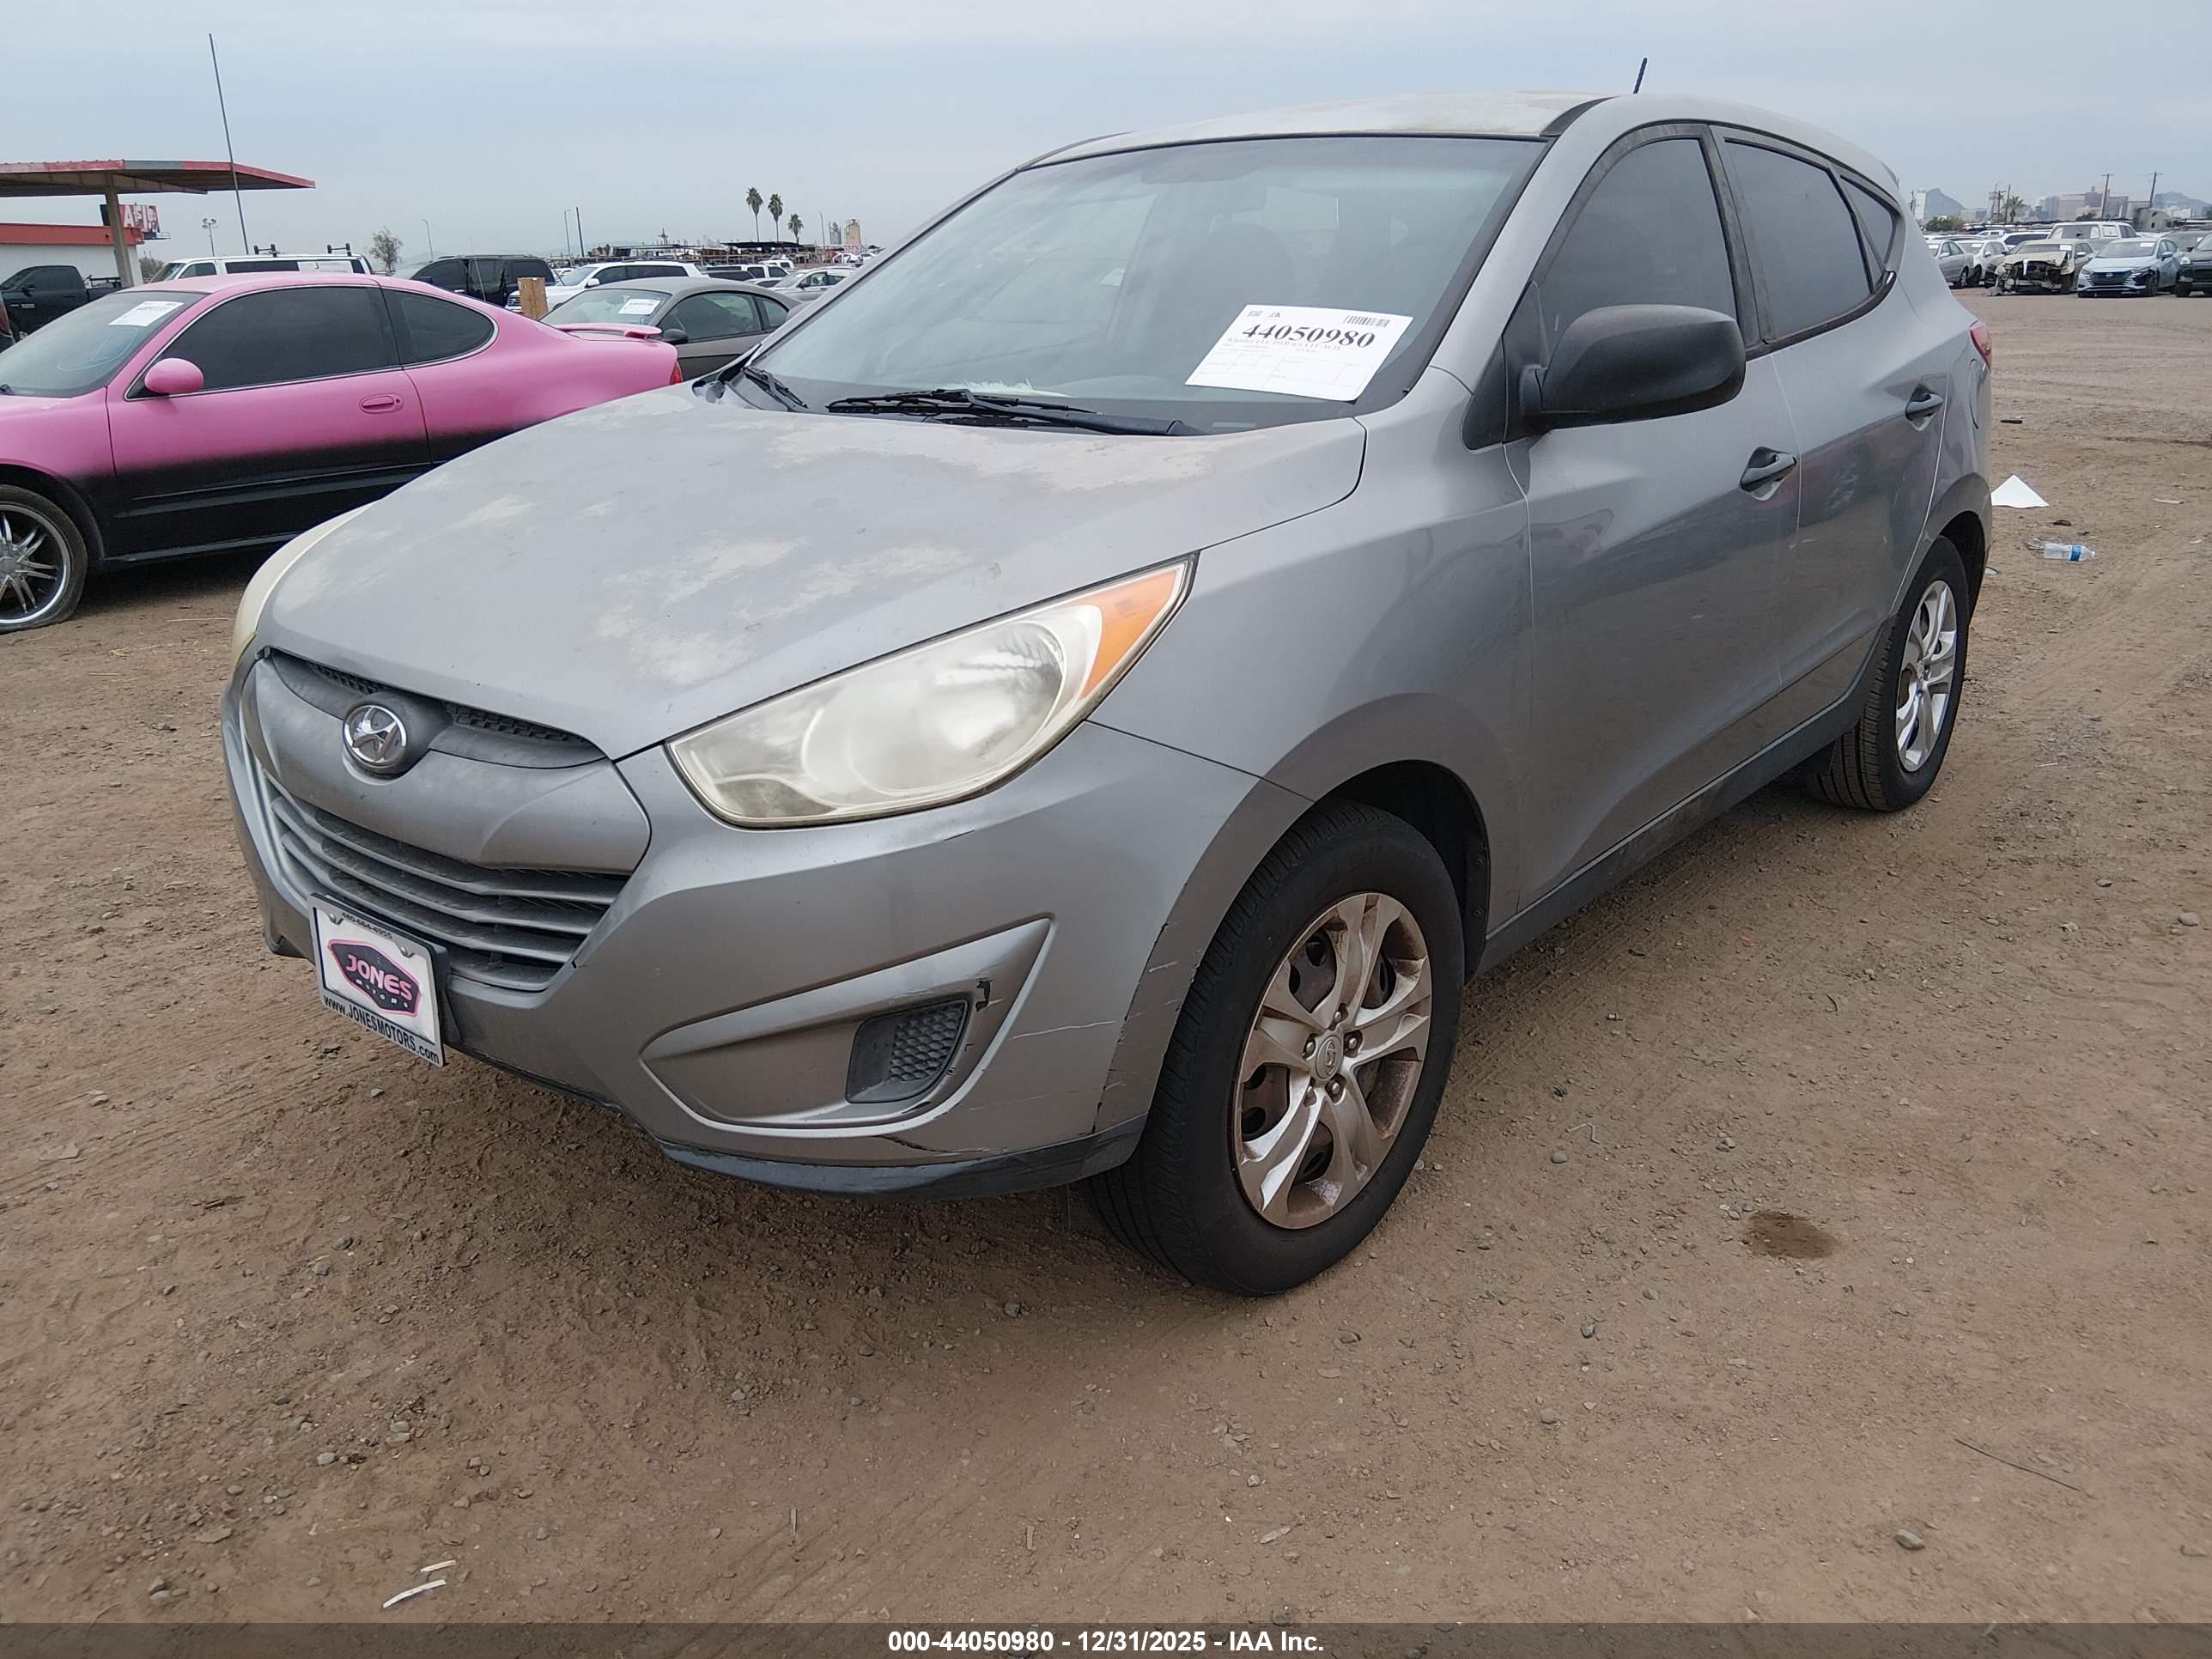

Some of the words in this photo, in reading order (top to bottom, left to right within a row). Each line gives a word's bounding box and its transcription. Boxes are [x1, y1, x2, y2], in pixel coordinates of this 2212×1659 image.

[1243, 324, 1376, 348] 44050980
[346, 954, 412, 1001] JONES
[324, 996, 440, 1064] www.JONESMOTORS.com
